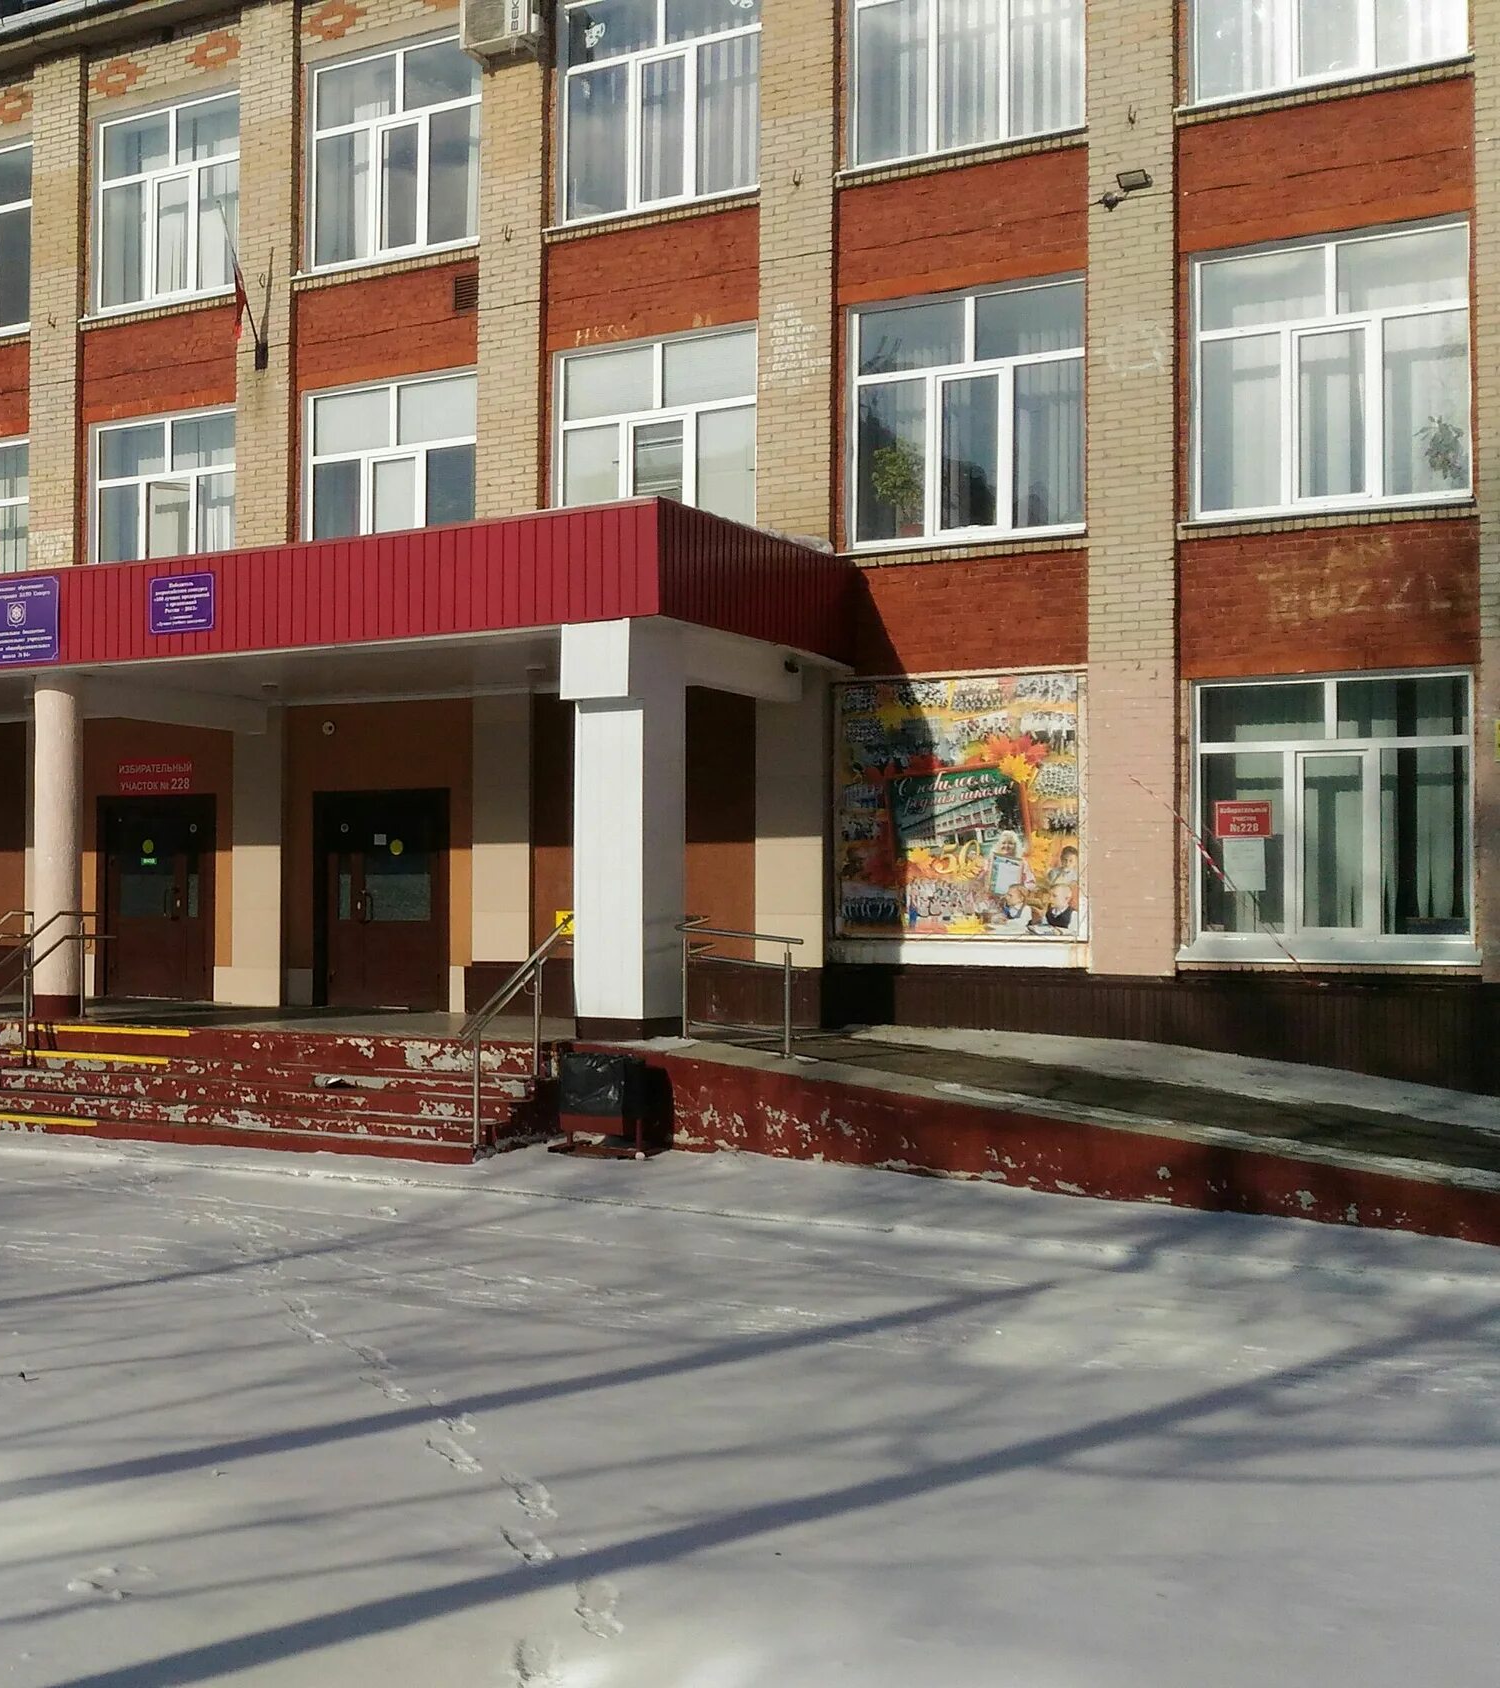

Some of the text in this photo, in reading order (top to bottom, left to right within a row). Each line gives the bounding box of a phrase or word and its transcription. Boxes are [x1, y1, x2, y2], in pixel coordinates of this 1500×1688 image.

[118, 761, 192, 774] ИЗБИРАТЕЛЬНЫЙ
[120, 777, 190, 791] УЧАСТОК № 228
[893, 777, 912, 796] С
[902, 781, 1015, 817] родная школа!
